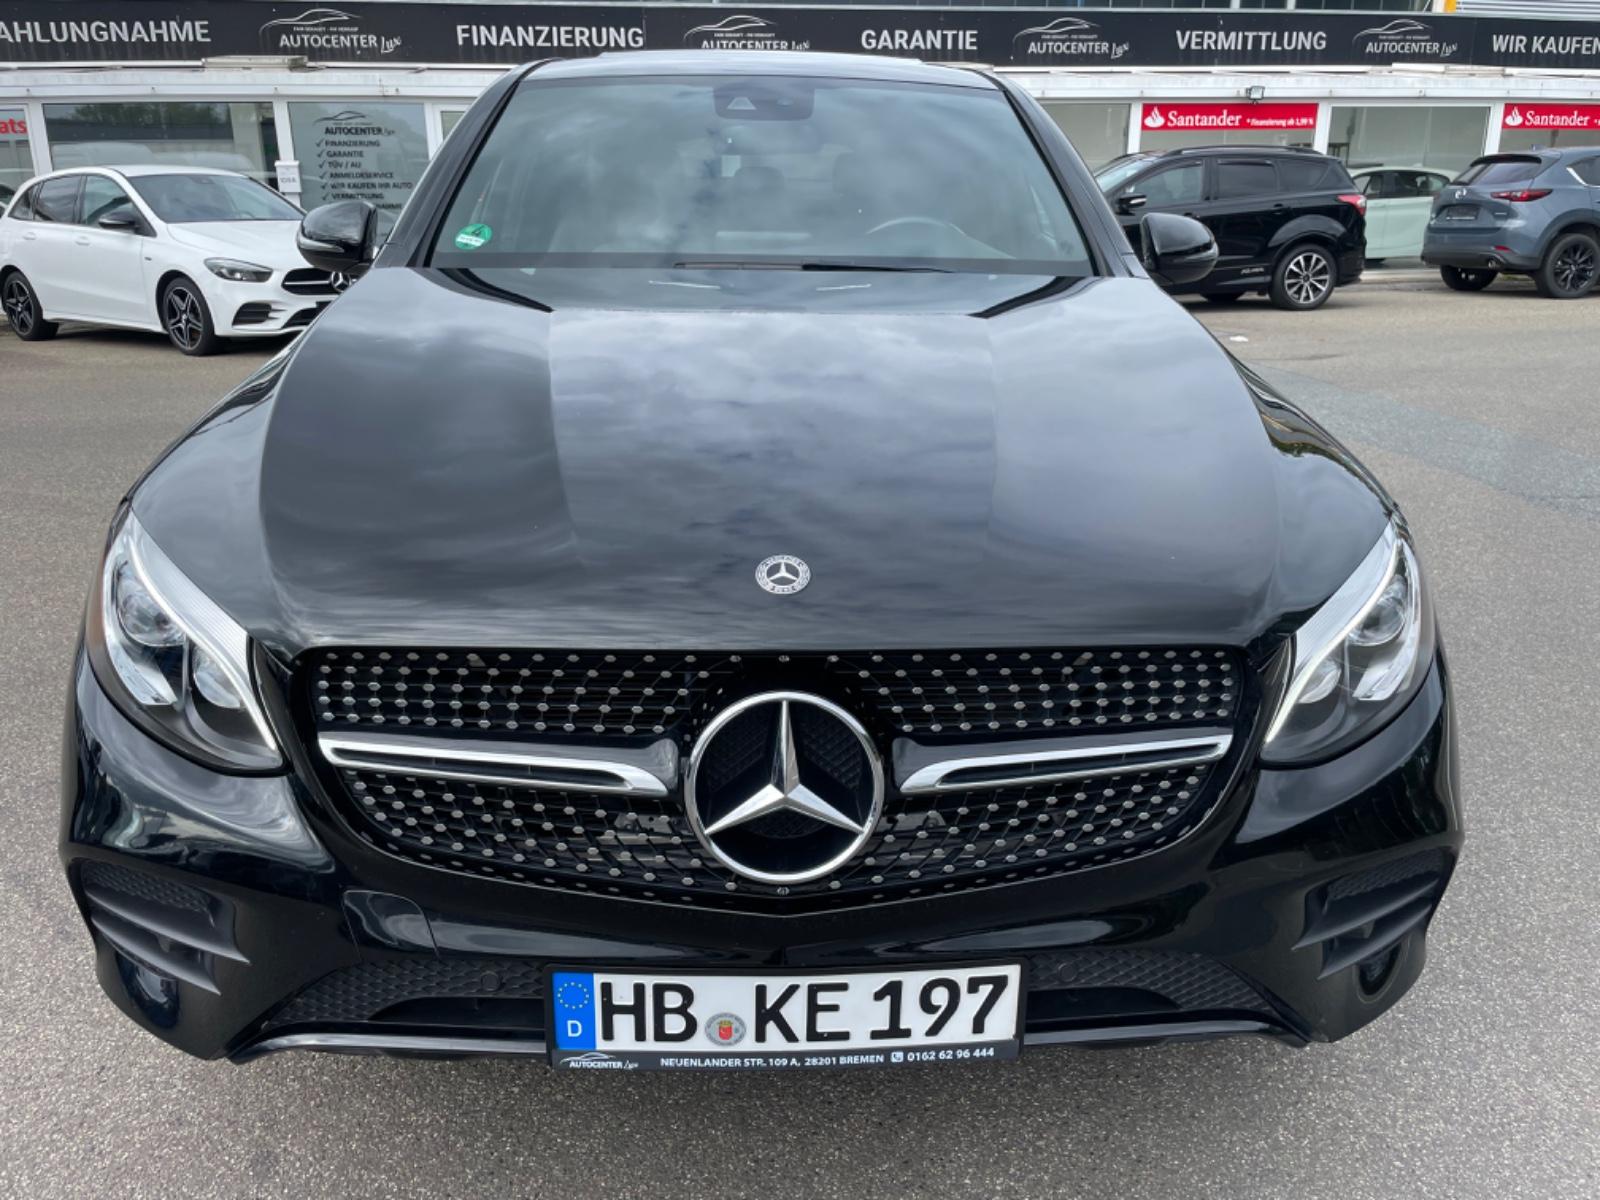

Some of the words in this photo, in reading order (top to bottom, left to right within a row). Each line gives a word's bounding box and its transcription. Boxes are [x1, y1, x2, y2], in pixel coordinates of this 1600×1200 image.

[0, 21, 211, 43] AHLUNGNAHME
[456, 25, 644, 48] FINANZIERUNG
[861, 30, 978, 50] GARANTIE
[280, 34, 378, 48] AUTOCENTER
[1028, 41, 1110, 54] AUTOCENTER
[1175, 31, 1327, 51] VERMITTLUNG
[1365, 42, 1440, 53] AUTOCENTER
[1493, 34, 1527, 53] WIR
[1531, 36, 1600, 54] KAUFEN
[1167, 109, 1242, 127] Santander
[1525, 110, 1591, 126] Santander
[325, 127, 382, 135] AUTOCENTER
[326, 150, 364, 158] GARANTIE
[599, 982, 698, 1043] HB
[755, 983, 850, 1043] KE
[869, 974, 1009, 1040] 197
[566, 1020, 583, 1037] D
[569, 1060, 623, 1069] AUTOCENTER
[660, 1058, 742, 1068] NEUENLANDER
[769, 1058, 788, 1067] 109
[804, 1056, 836, 1066] 28201
[839, 1054, 885, 1065] BREMEN
[907, 1051, 936, 1062] 0162
[938, 1050, 954, 1060] 62
[956, 1049, 971, 1059] 96
[972, 1047, 995, 1057] 444
